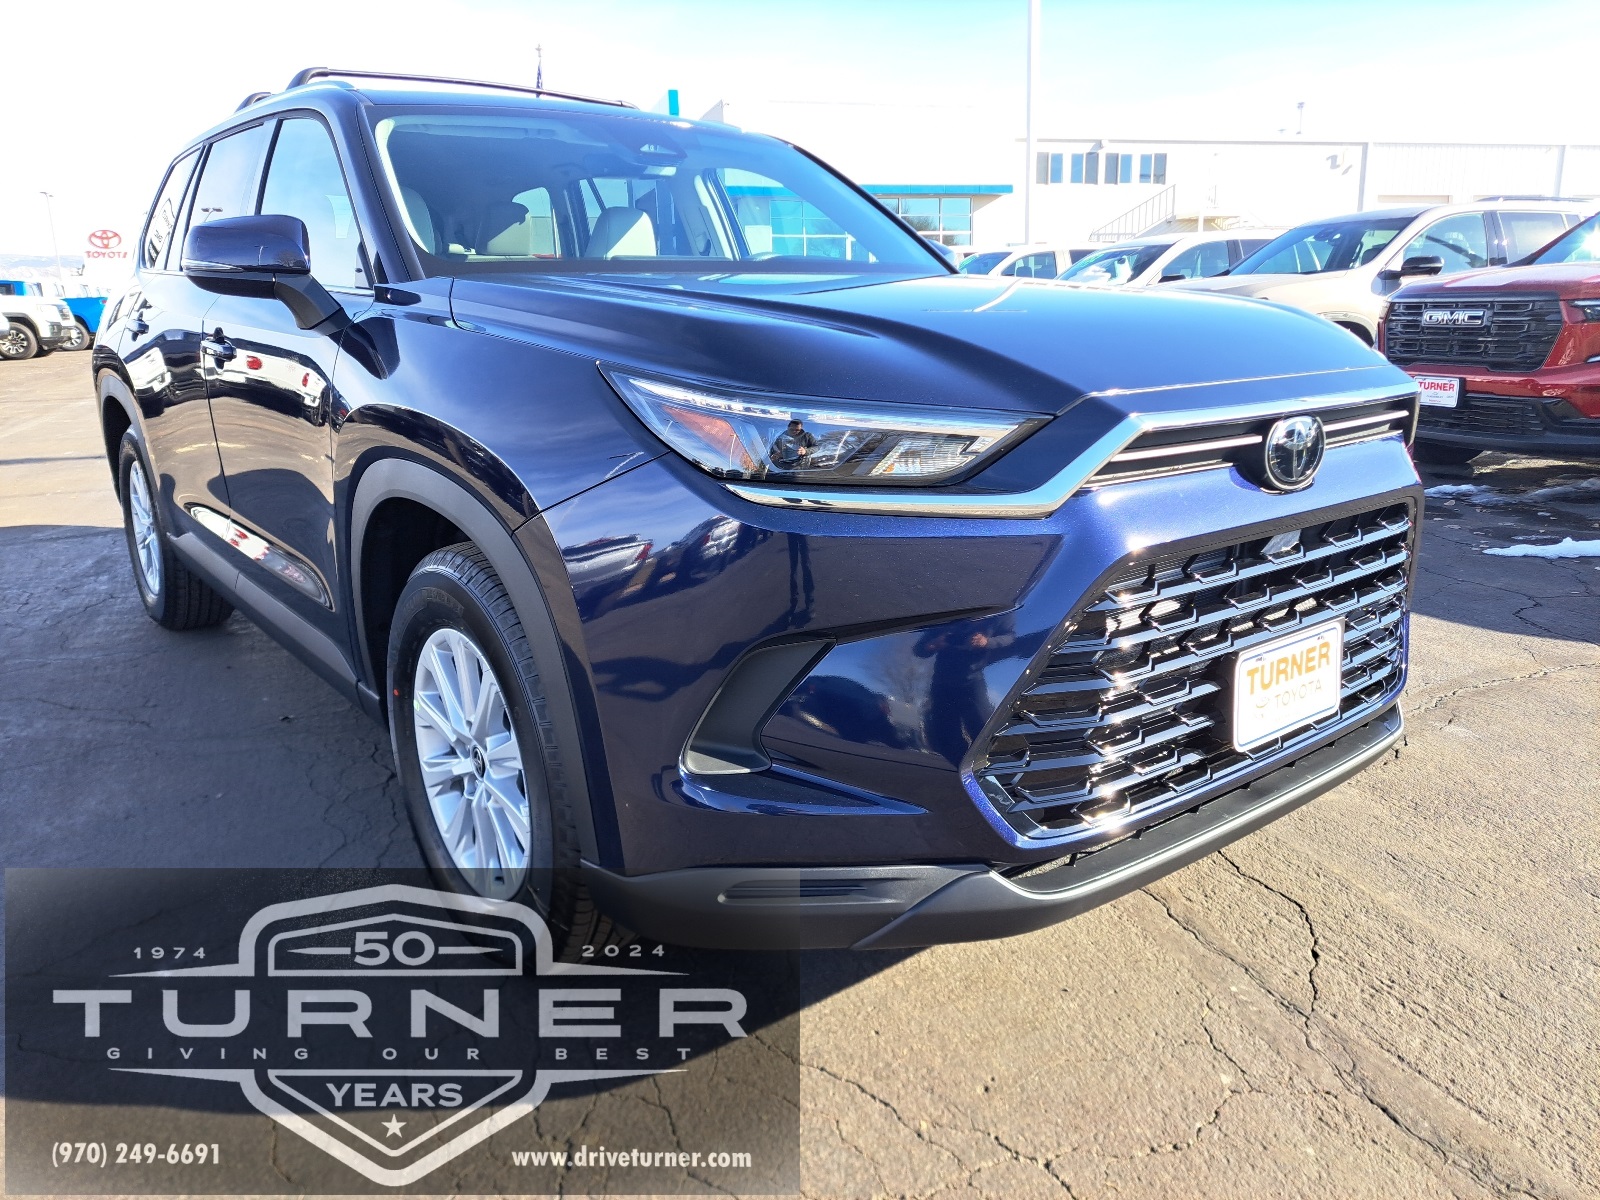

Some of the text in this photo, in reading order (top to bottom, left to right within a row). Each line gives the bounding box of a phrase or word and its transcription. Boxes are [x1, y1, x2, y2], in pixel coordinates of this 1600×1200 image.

[1424, 310, 1484, 325] GMC
[1418, 381, 1455, 392] TURNER
[1246, 641, 1331, 696] TURNER
[1274, 679, 1322, 708] TOYOTA
